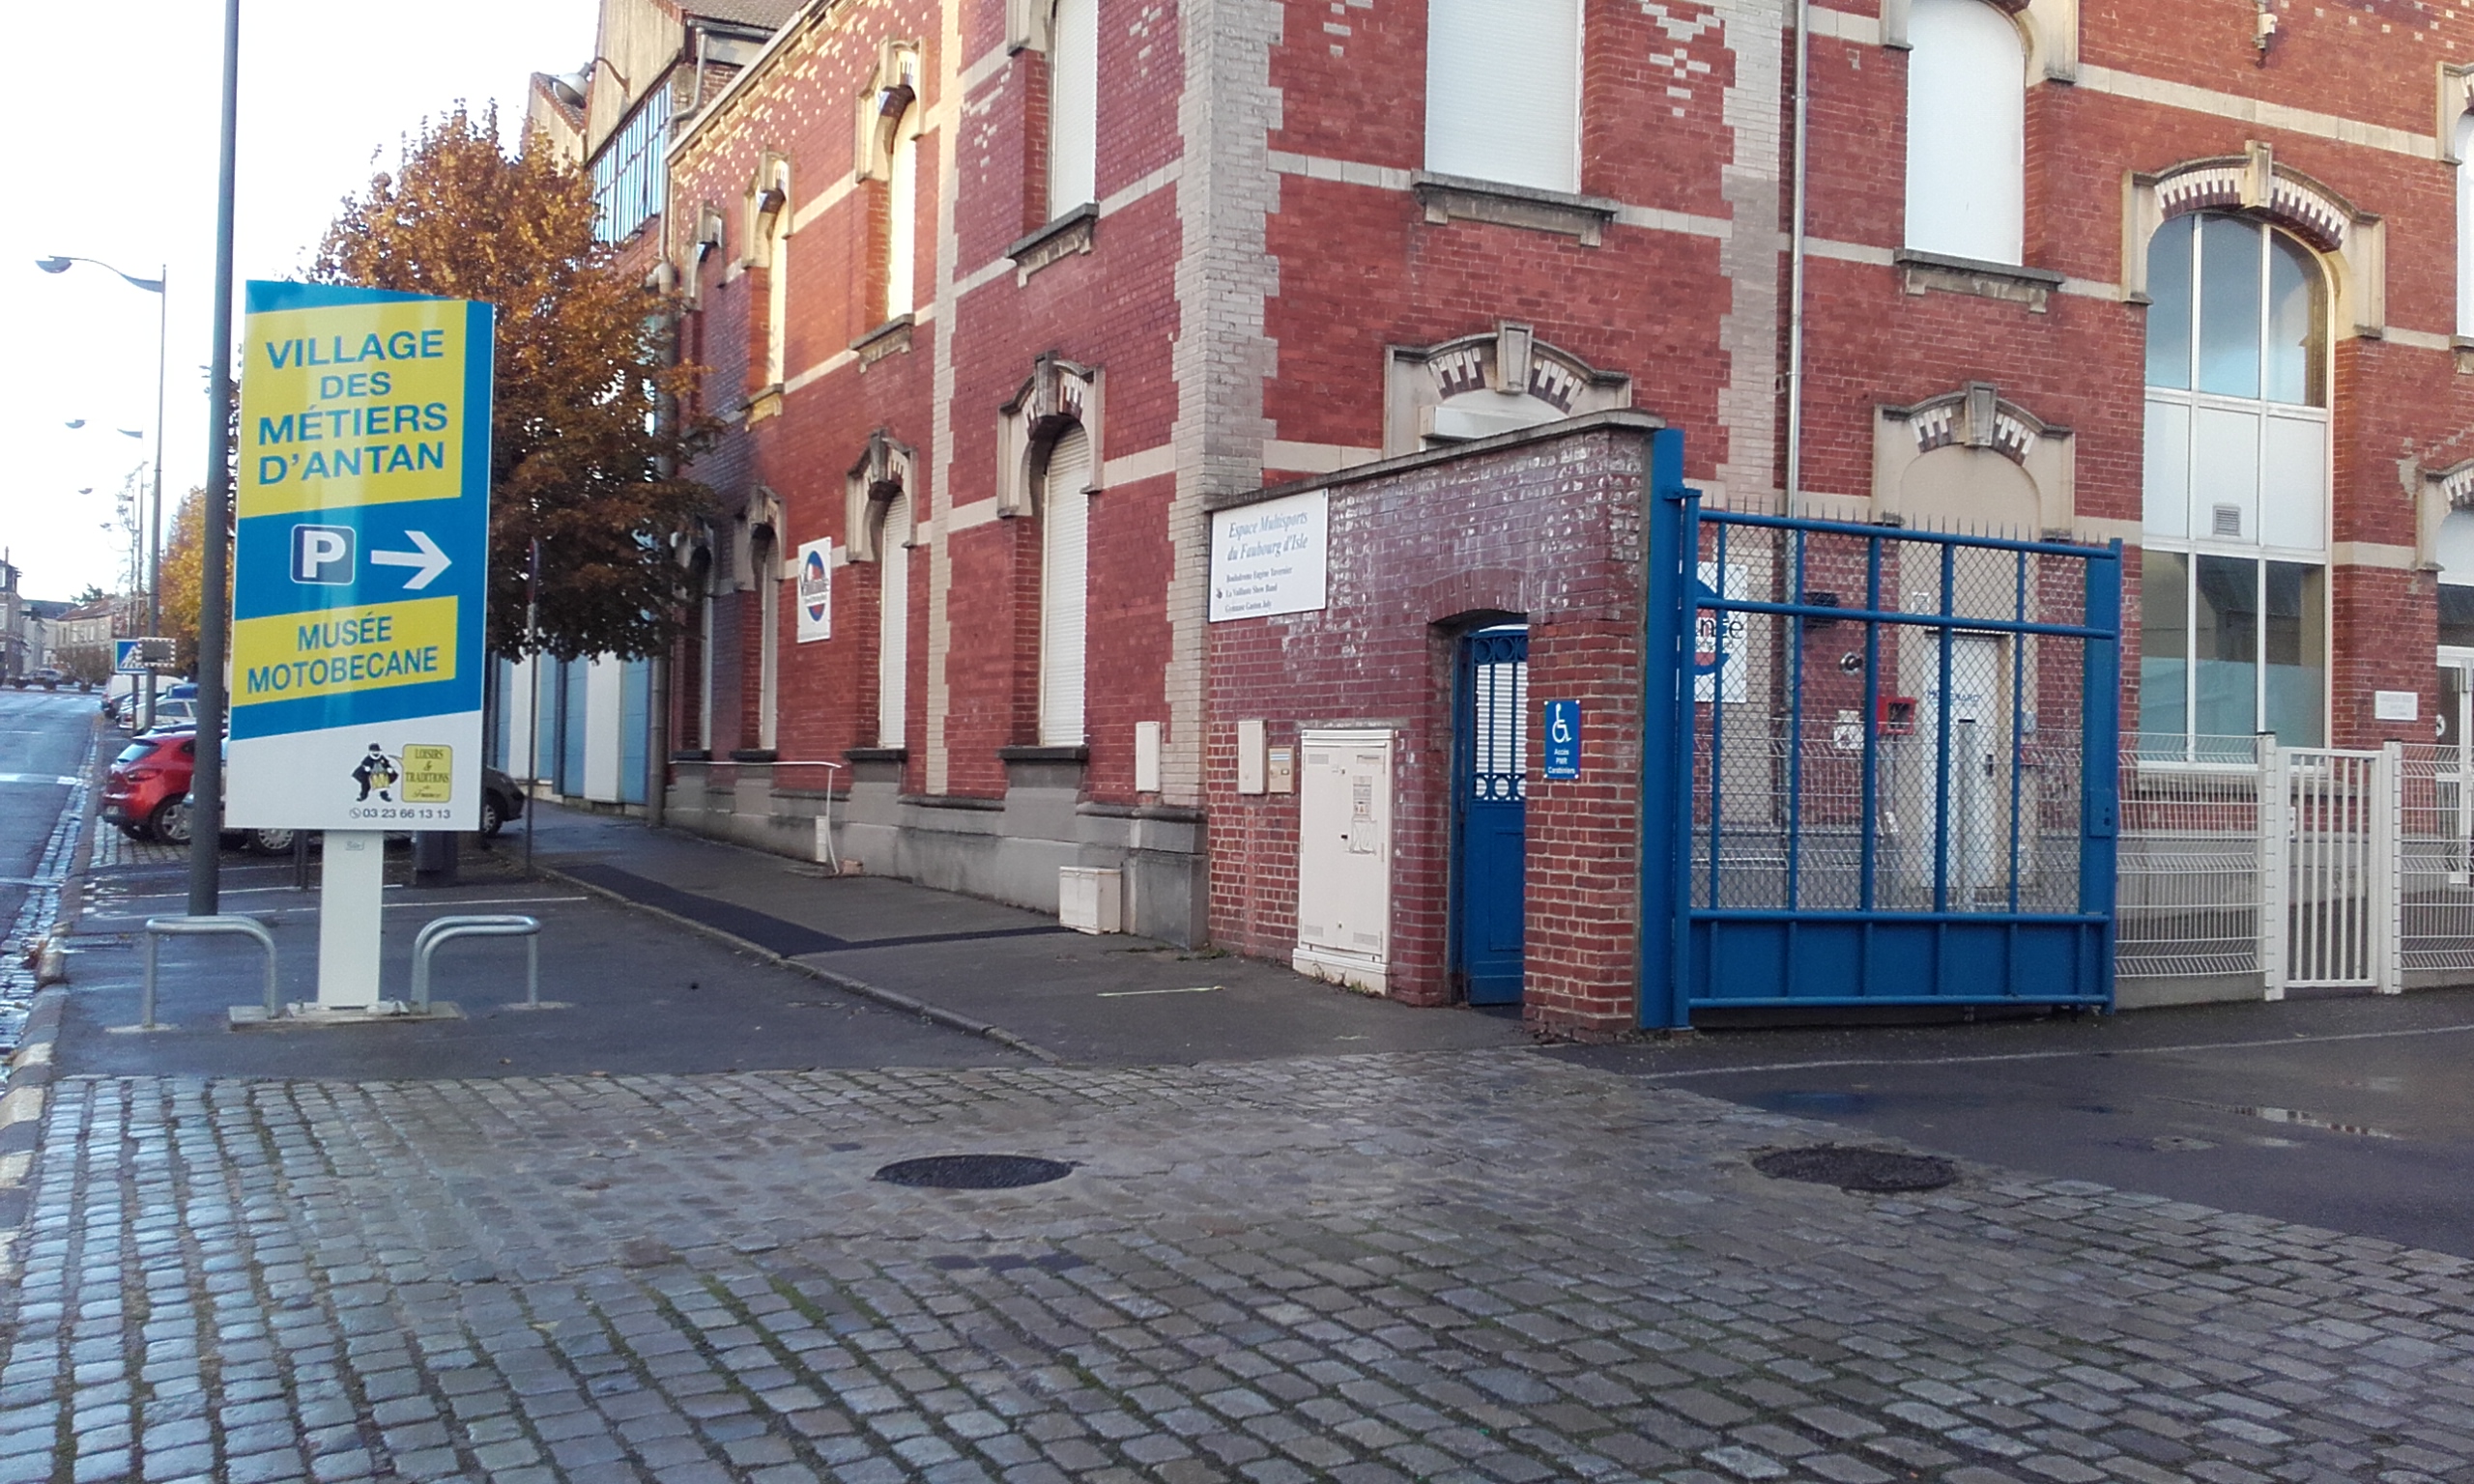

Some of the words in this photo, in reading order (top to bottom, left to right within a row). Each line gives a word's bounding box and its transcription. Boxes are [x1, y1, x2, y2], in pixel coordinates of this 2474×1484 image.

[266, 329, 445, 369] VILLAGE
[320, 371, 392, 401] DES
[258, 402, 448, 446] MÉTIERS
[258, 441, 445, 486] D'ANTAN
[1228, 522, 1258, 541] Espace
[1259, 511, 1309, 532] Multisports
[302, 530, 346, 579] P
[1227, 545, 1239, 561] du
[1240, 540, 1282, 559] Faubourg
[1282, 532, 1309, 552] d'Isle
[297, 611, 392, 652] MUSÉE
[246, 645, 439, 695] MOTOBECANE
[414, 748, 445, 760] LOISIRS
[405, 772, 450, 784] TRADITIONS
[361, 808, 379, 819] 03
[381, 808, 397, 819] 23
[399, 808, 416, 819] 66
[418, 809, 434, 820] 13
[437, 809, 451, 820] 13
